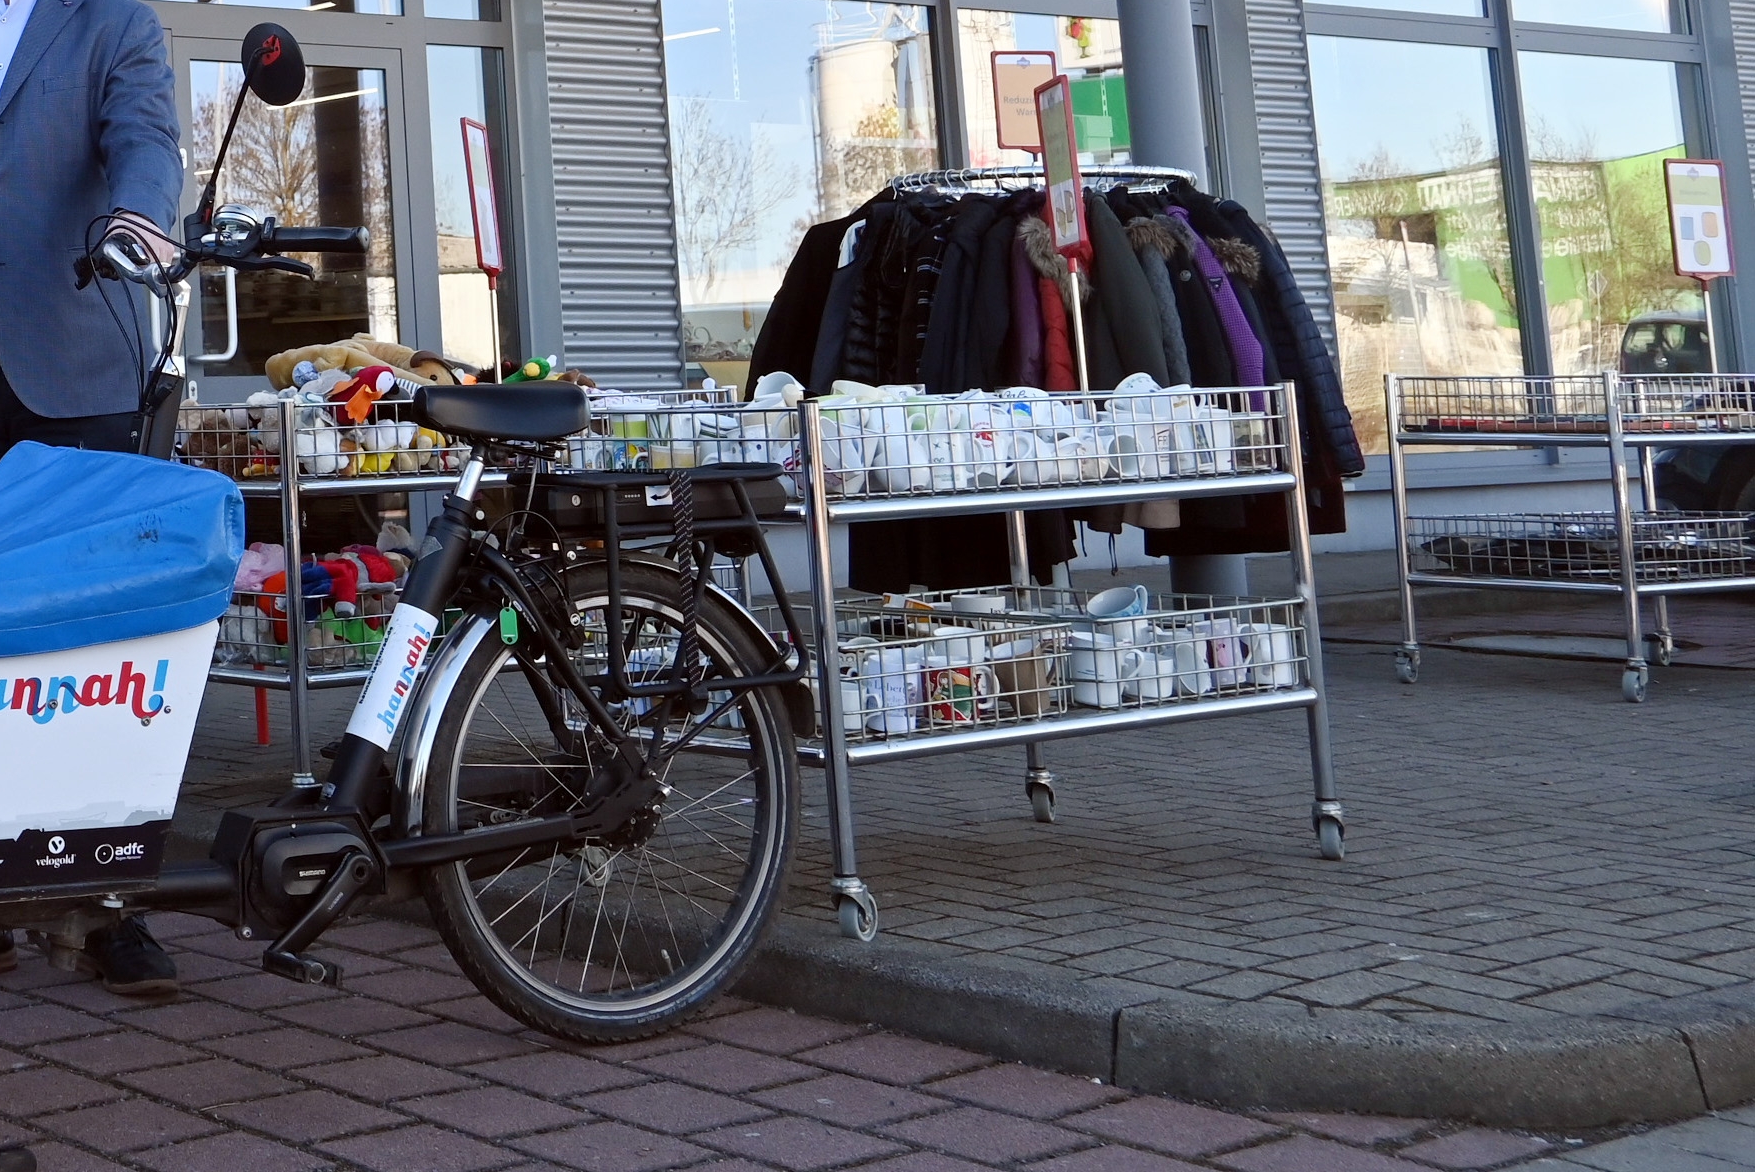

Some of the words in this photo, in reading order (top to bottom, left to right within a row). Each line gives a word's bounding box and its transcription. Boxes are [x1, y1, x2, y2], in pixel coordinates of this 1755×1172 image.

[1003, 95, 1034, 105] Reduzi
[1016, 108, 1037, 116] War
[377, 623, 430, 734] hannah!
[115, 842, 145, 856] adfc
[36, 854, 75, 869] velogold
